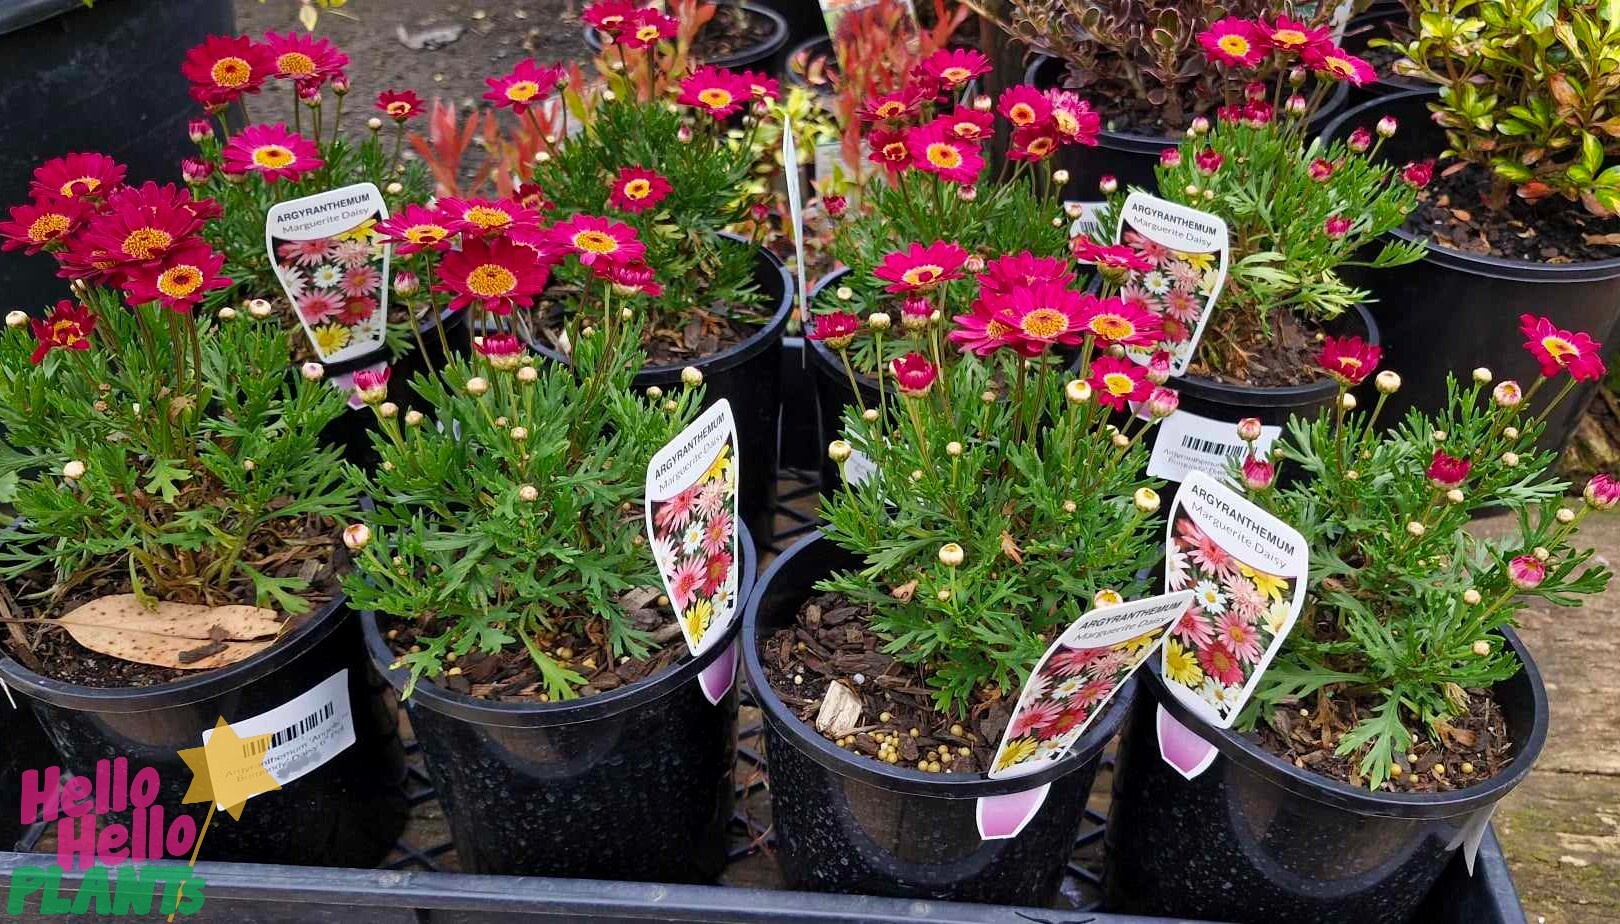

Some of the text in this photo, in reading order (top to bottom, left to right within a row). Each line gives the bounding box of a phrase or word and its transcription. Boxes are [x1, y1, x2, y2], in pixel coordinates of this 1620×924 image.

[277, 193, 370, 223] ARGYRANTHEMUM
[283, 207, 369, 234] Marguerite Daisy
[1132, 203, 1217, 236] ARGYRANTHEMUM
[1133, 215, 1212, 248] Marguerite Daisy
[655, 412, 725, 480] ARGYRANTHEMUM
[659, 432, 723, 493] Marguerite Daisy
[1192, 484, 1295, 556] ARGYRANTHEMUM
[1192, 501, 1287, 569] Marguerite Daisy
[1074, 615, 1168, 641] Marguerite Daisy
[1080, 601, 1182, 630] ARGYRANTHEMUM
